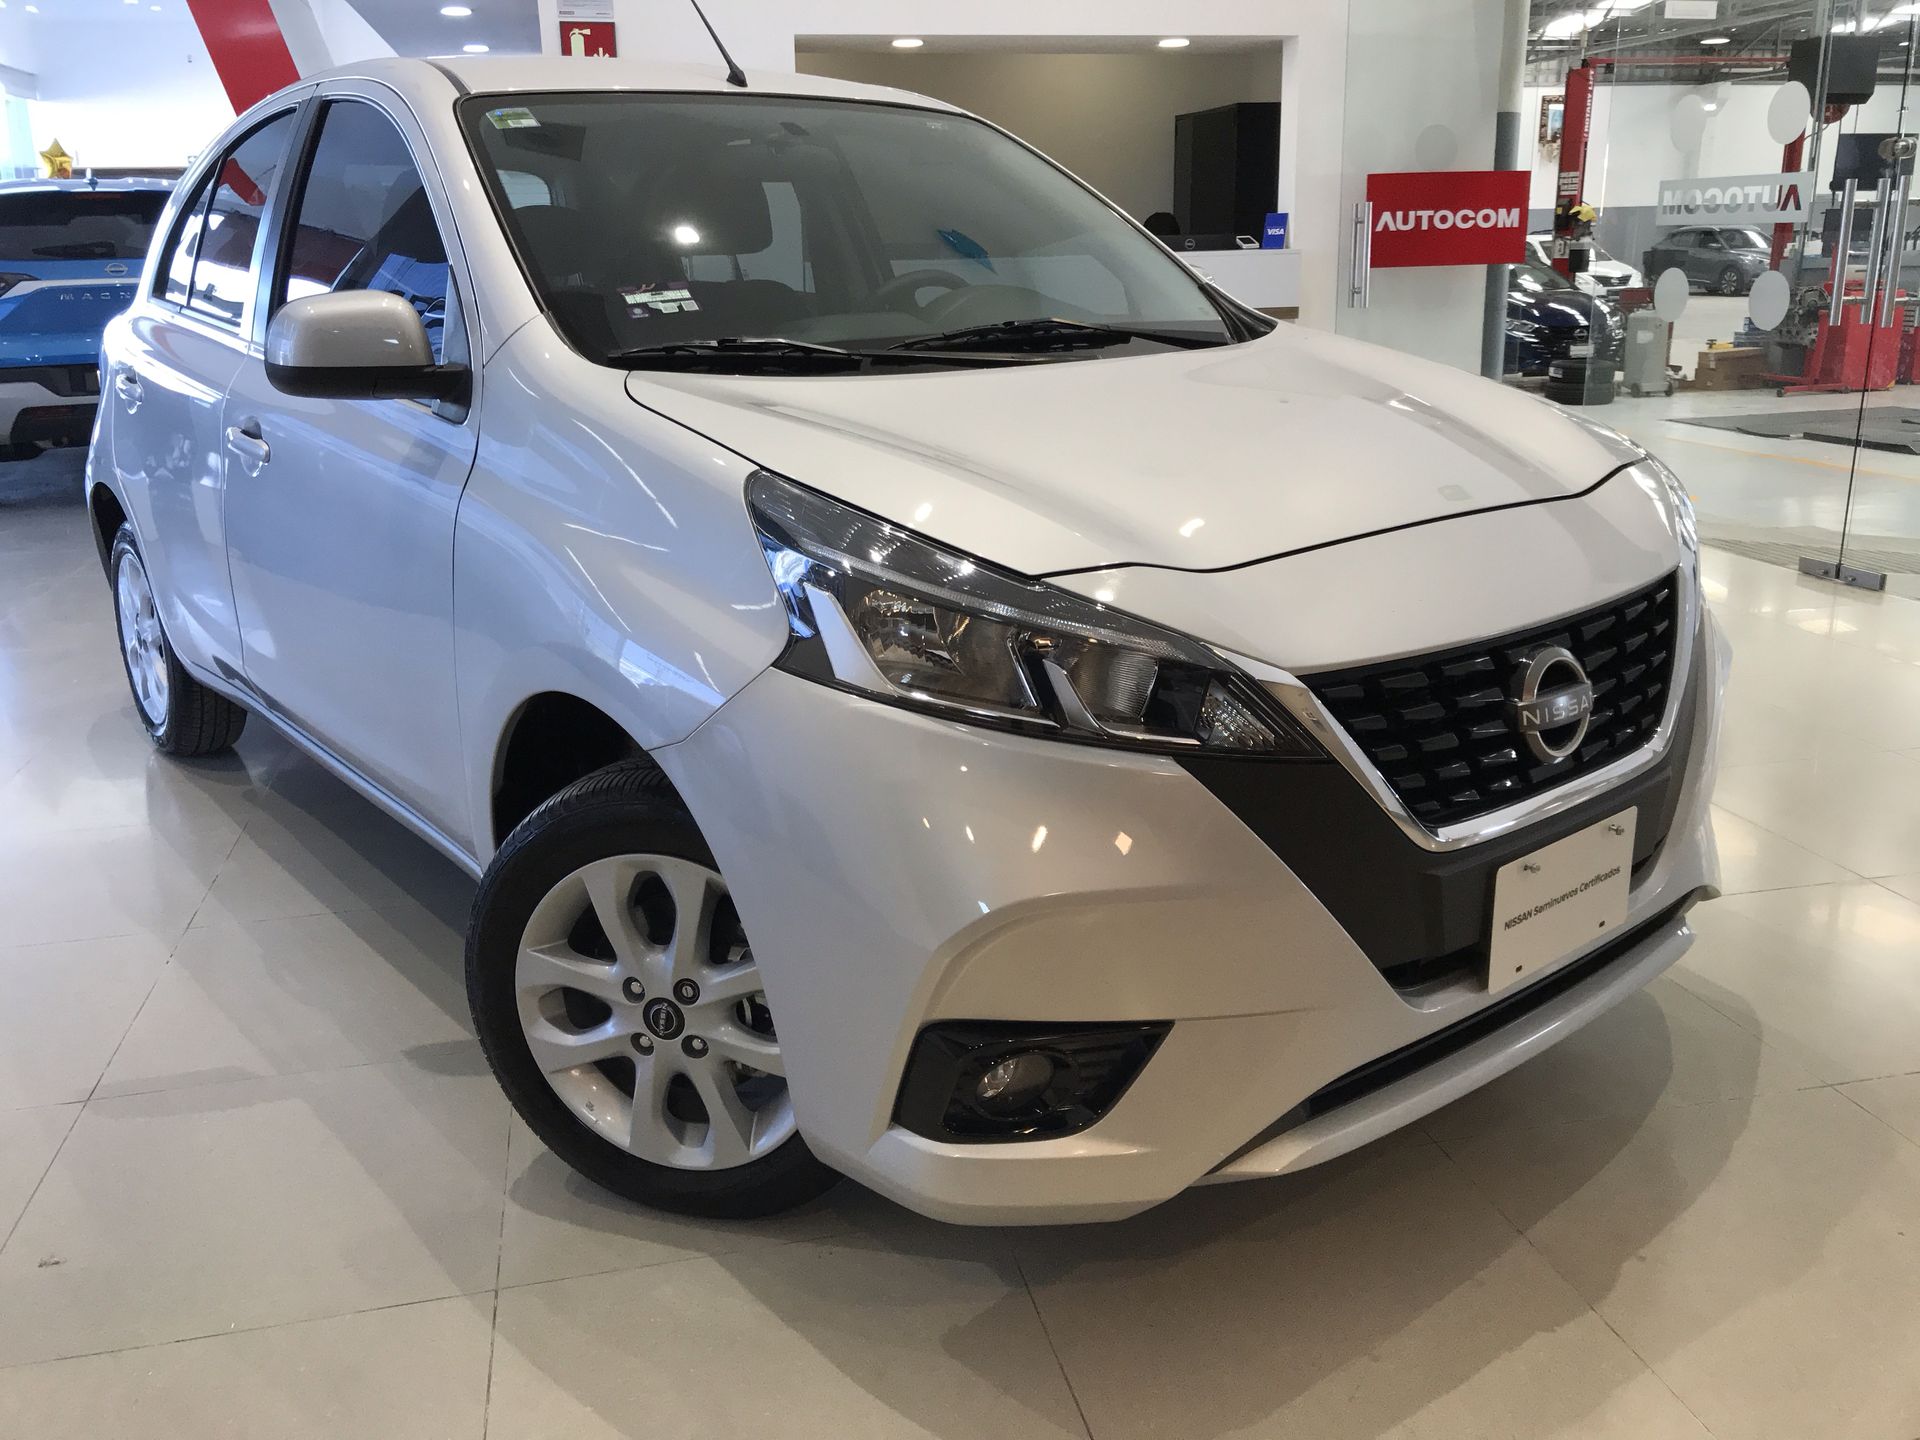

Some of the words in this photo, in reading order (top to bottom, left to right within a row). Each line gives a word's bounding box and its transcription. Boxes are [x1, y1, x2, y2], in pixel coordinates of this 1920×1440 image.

[1375, 208, 1521, 232] AUTOCOM
[1504, 909, 1533, 932] NISSAN
[1533, 887, 1579, 917] Seminuevos
[1579, 866, 1621, 893] Certificados
[658, 1002, 669, 1036] NISSAN
